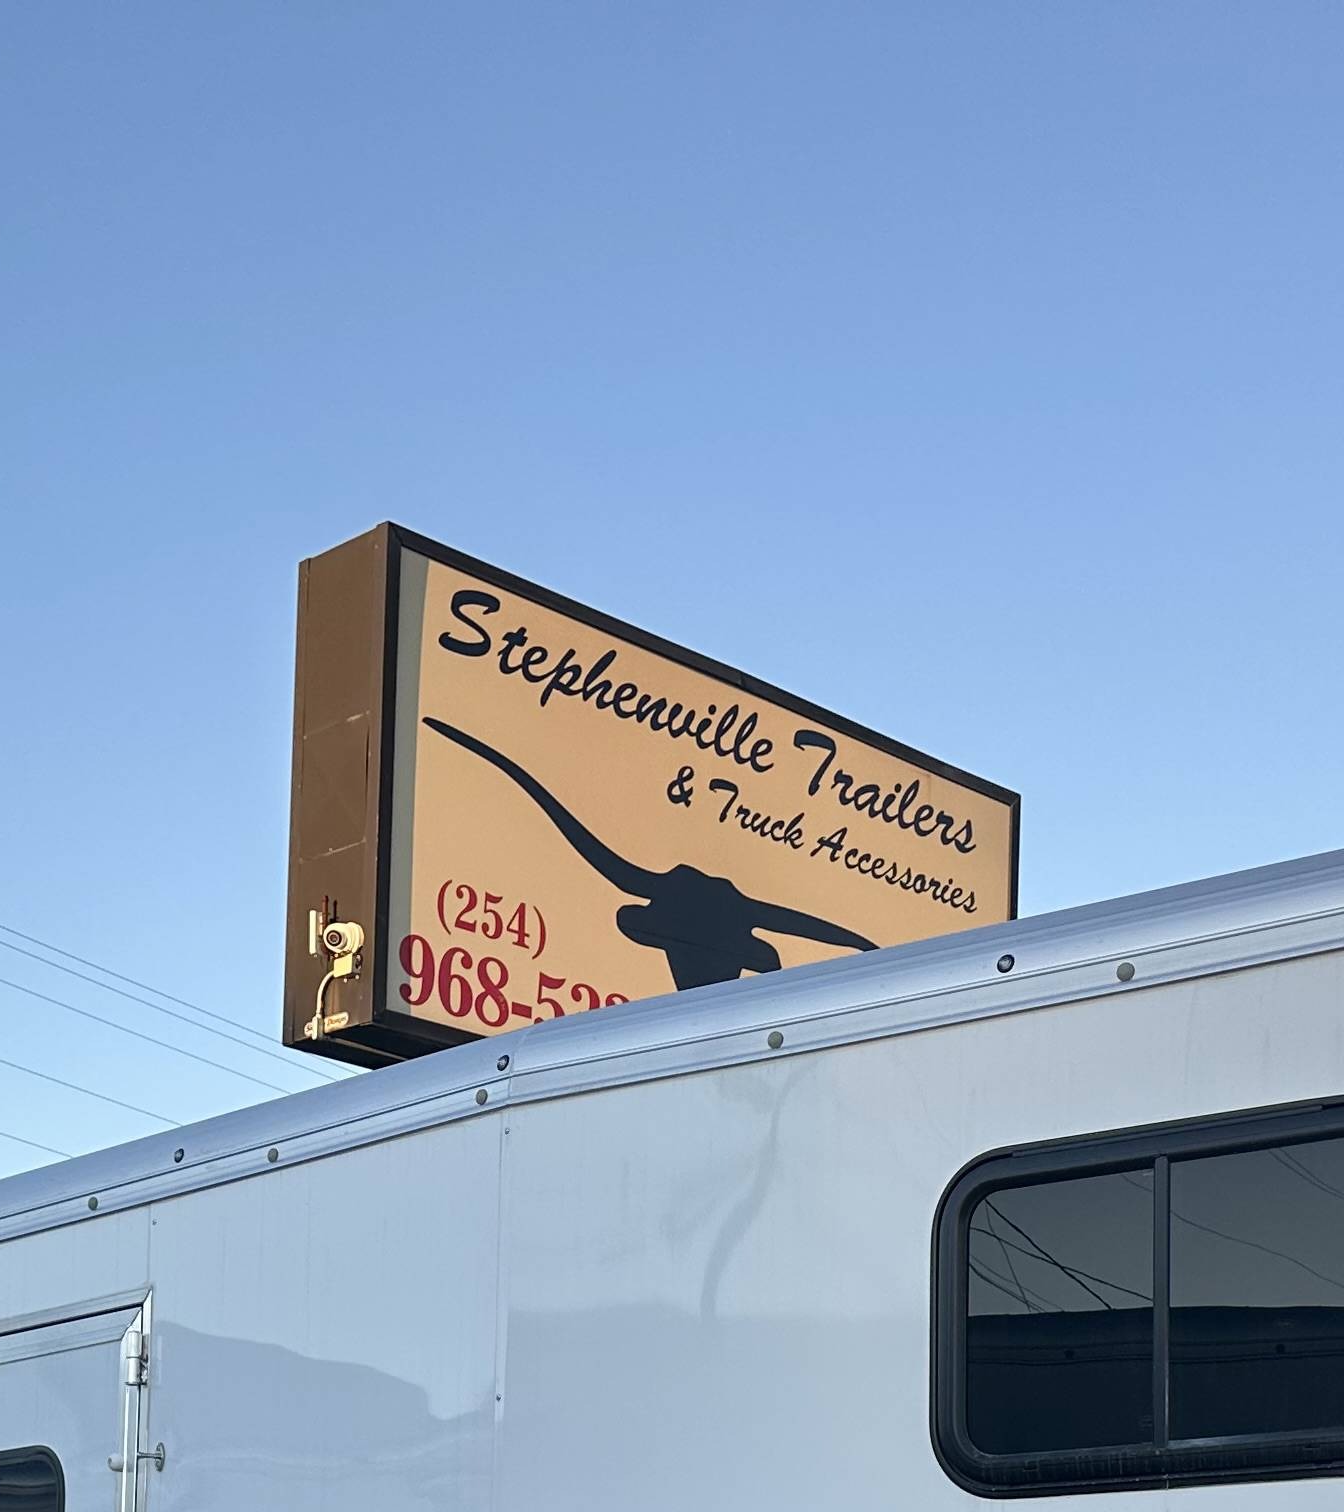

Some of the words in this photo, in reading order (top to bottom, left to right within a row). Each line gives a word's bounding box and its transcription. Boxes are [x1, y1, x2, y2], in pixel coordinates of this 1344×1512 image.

[438, 590, 775, 773] Stephenville
[793, 729, 977, 854] Trailers
[667, 766, 695, 808] &
[709, 778, 805, 850] Truck
[810, 827, 978, 914] Accessories
[436, 879, 547, 960] (254)
